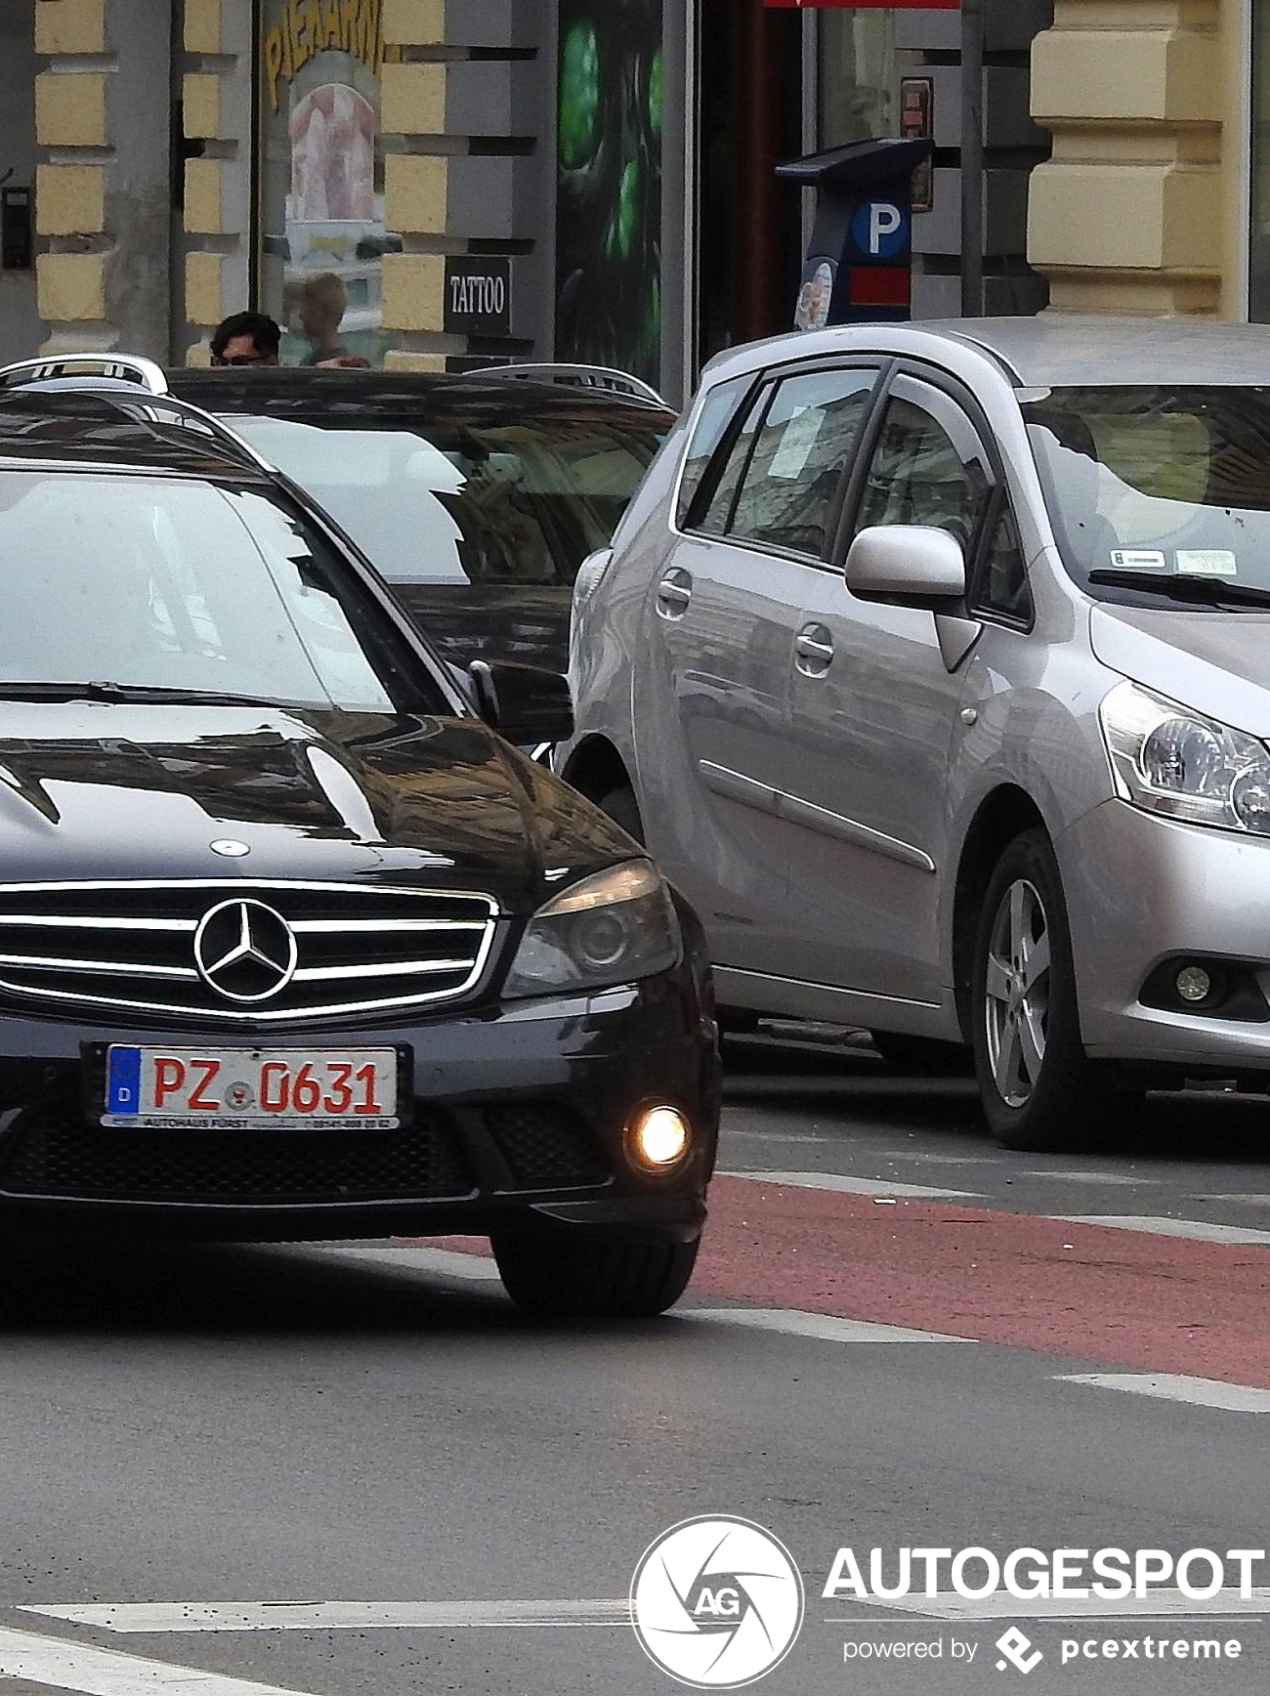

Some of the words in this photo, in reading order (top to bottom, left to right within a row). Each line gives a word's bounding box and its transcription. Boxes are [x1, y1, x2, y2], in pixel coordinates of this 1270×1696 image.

[870, 203, 901, 254] P
[450, 275, 505, 315] TATTOO
[117, 1087, 130, 1102] D
[153, 1057, 223, 1110] PZ
[259, 1060, 383, 1114] 0631
[143, 1117, 209, 1128] AUTOHAUS
